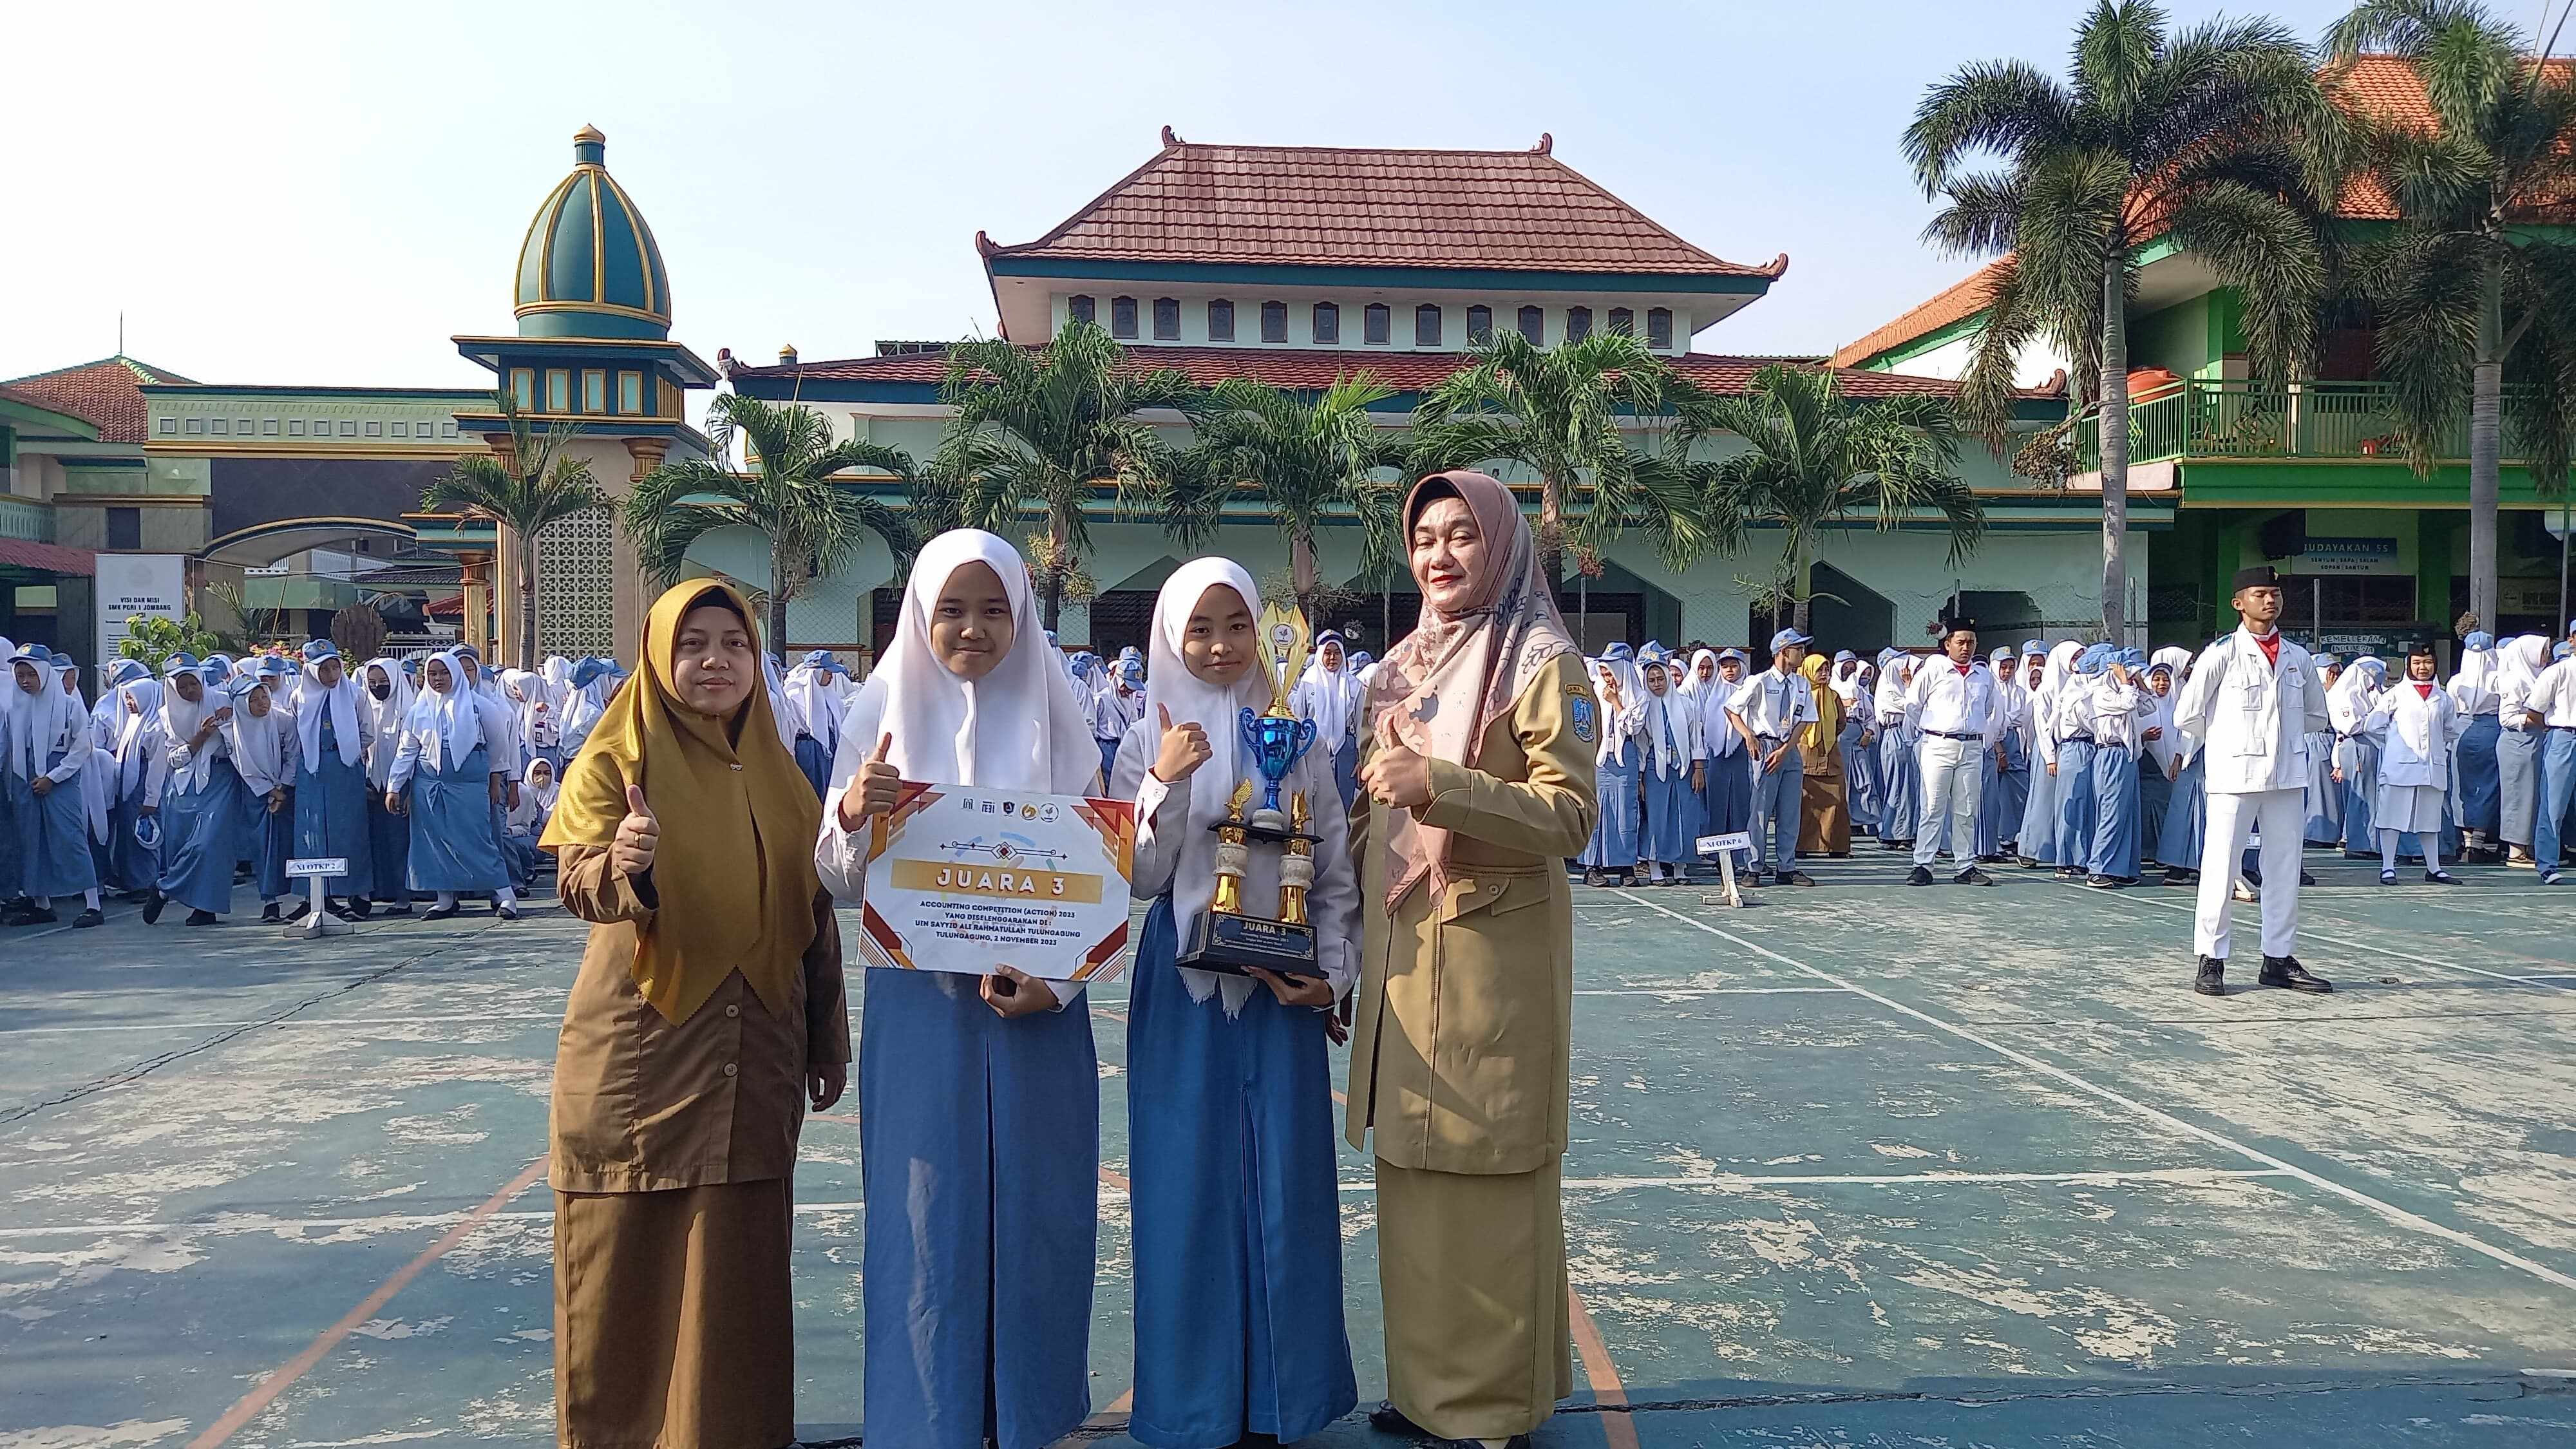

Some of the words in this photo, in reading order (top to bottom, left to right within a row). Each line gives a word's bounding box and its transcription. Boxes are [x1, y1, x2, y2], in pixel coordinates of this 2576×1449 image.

[2376, 544, 2389, 553] 5S
[936, 868, 1036, 893] JUARA
[1051, 877, 1065, 895] 3
[920, 901, 971, 910] ACCOUNTING
[972, 904, 1022, 913] COMPETITION
[1023, 908, 1057, 917] (ACTION)
[967, 914, 1037, 924] DISELENGGARAKAN
[973, 924, 1026, 933] RAHMATULLAH
[1028, 928, 1081, 938] TULUNGAGUNG
[1243, 922, 1276, 934] JUARA
[1000, 936, 1039, 944] NOVEMBER
